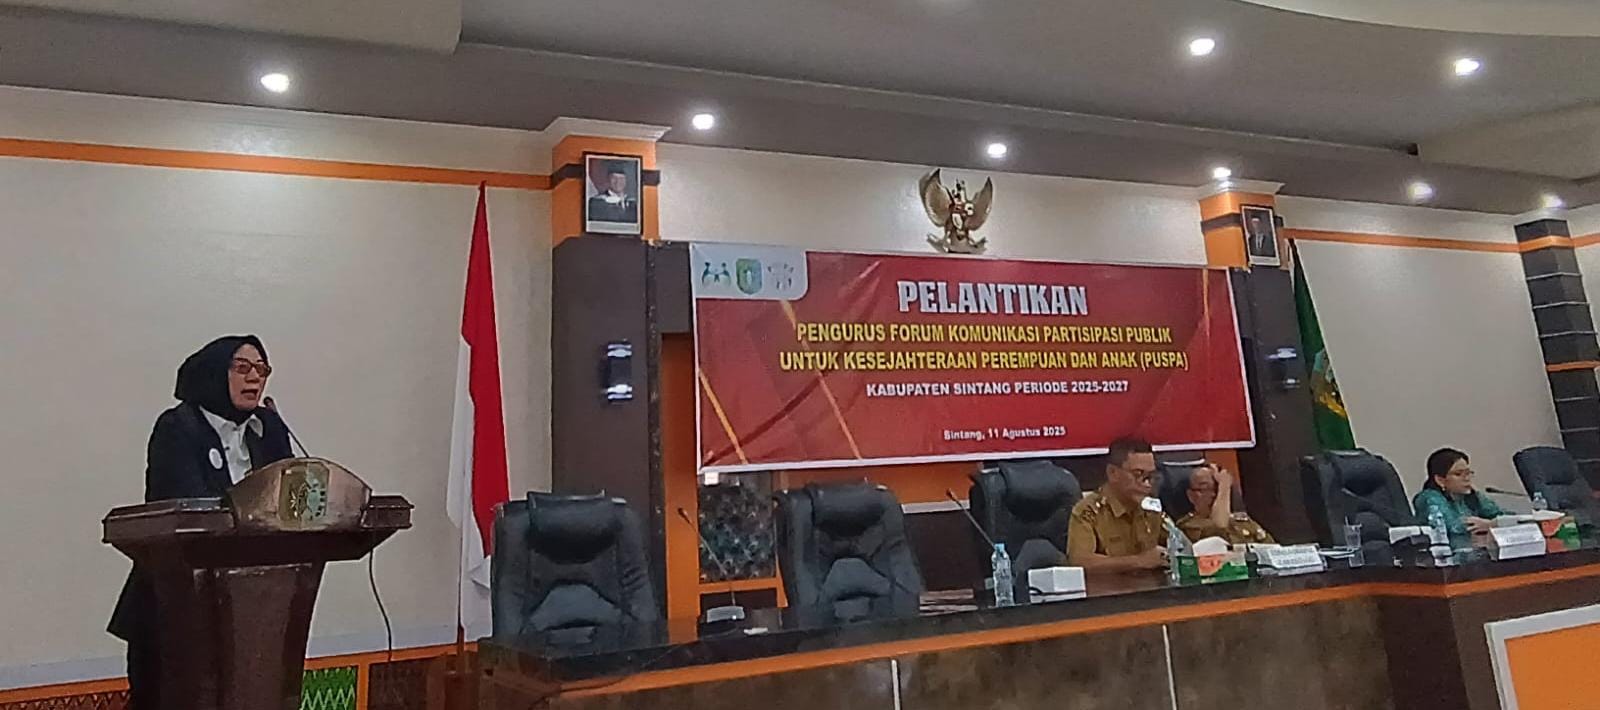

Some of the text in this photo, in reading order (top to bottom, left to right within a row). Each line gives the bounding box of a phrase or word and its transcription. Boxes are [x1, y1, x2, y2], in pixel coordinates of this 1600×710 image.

[897, 281, 1088, 315] PELANTIKAN
[797, 323, 1172, 343] PENGURUS FORUM KOMUNIKASI PARTISIPASI PUBLIK
[780, 351, 1189, 371] UNTUK KESEJAHTERAAN PEREMPUAN DAN ANAK (PUSPA)
[867, 381, 1129, 396] KABUPATEN SINTANG PERIODE 2025-2027
[944, 426, 1066, 441] Sintang, 11 Agustus 2025
